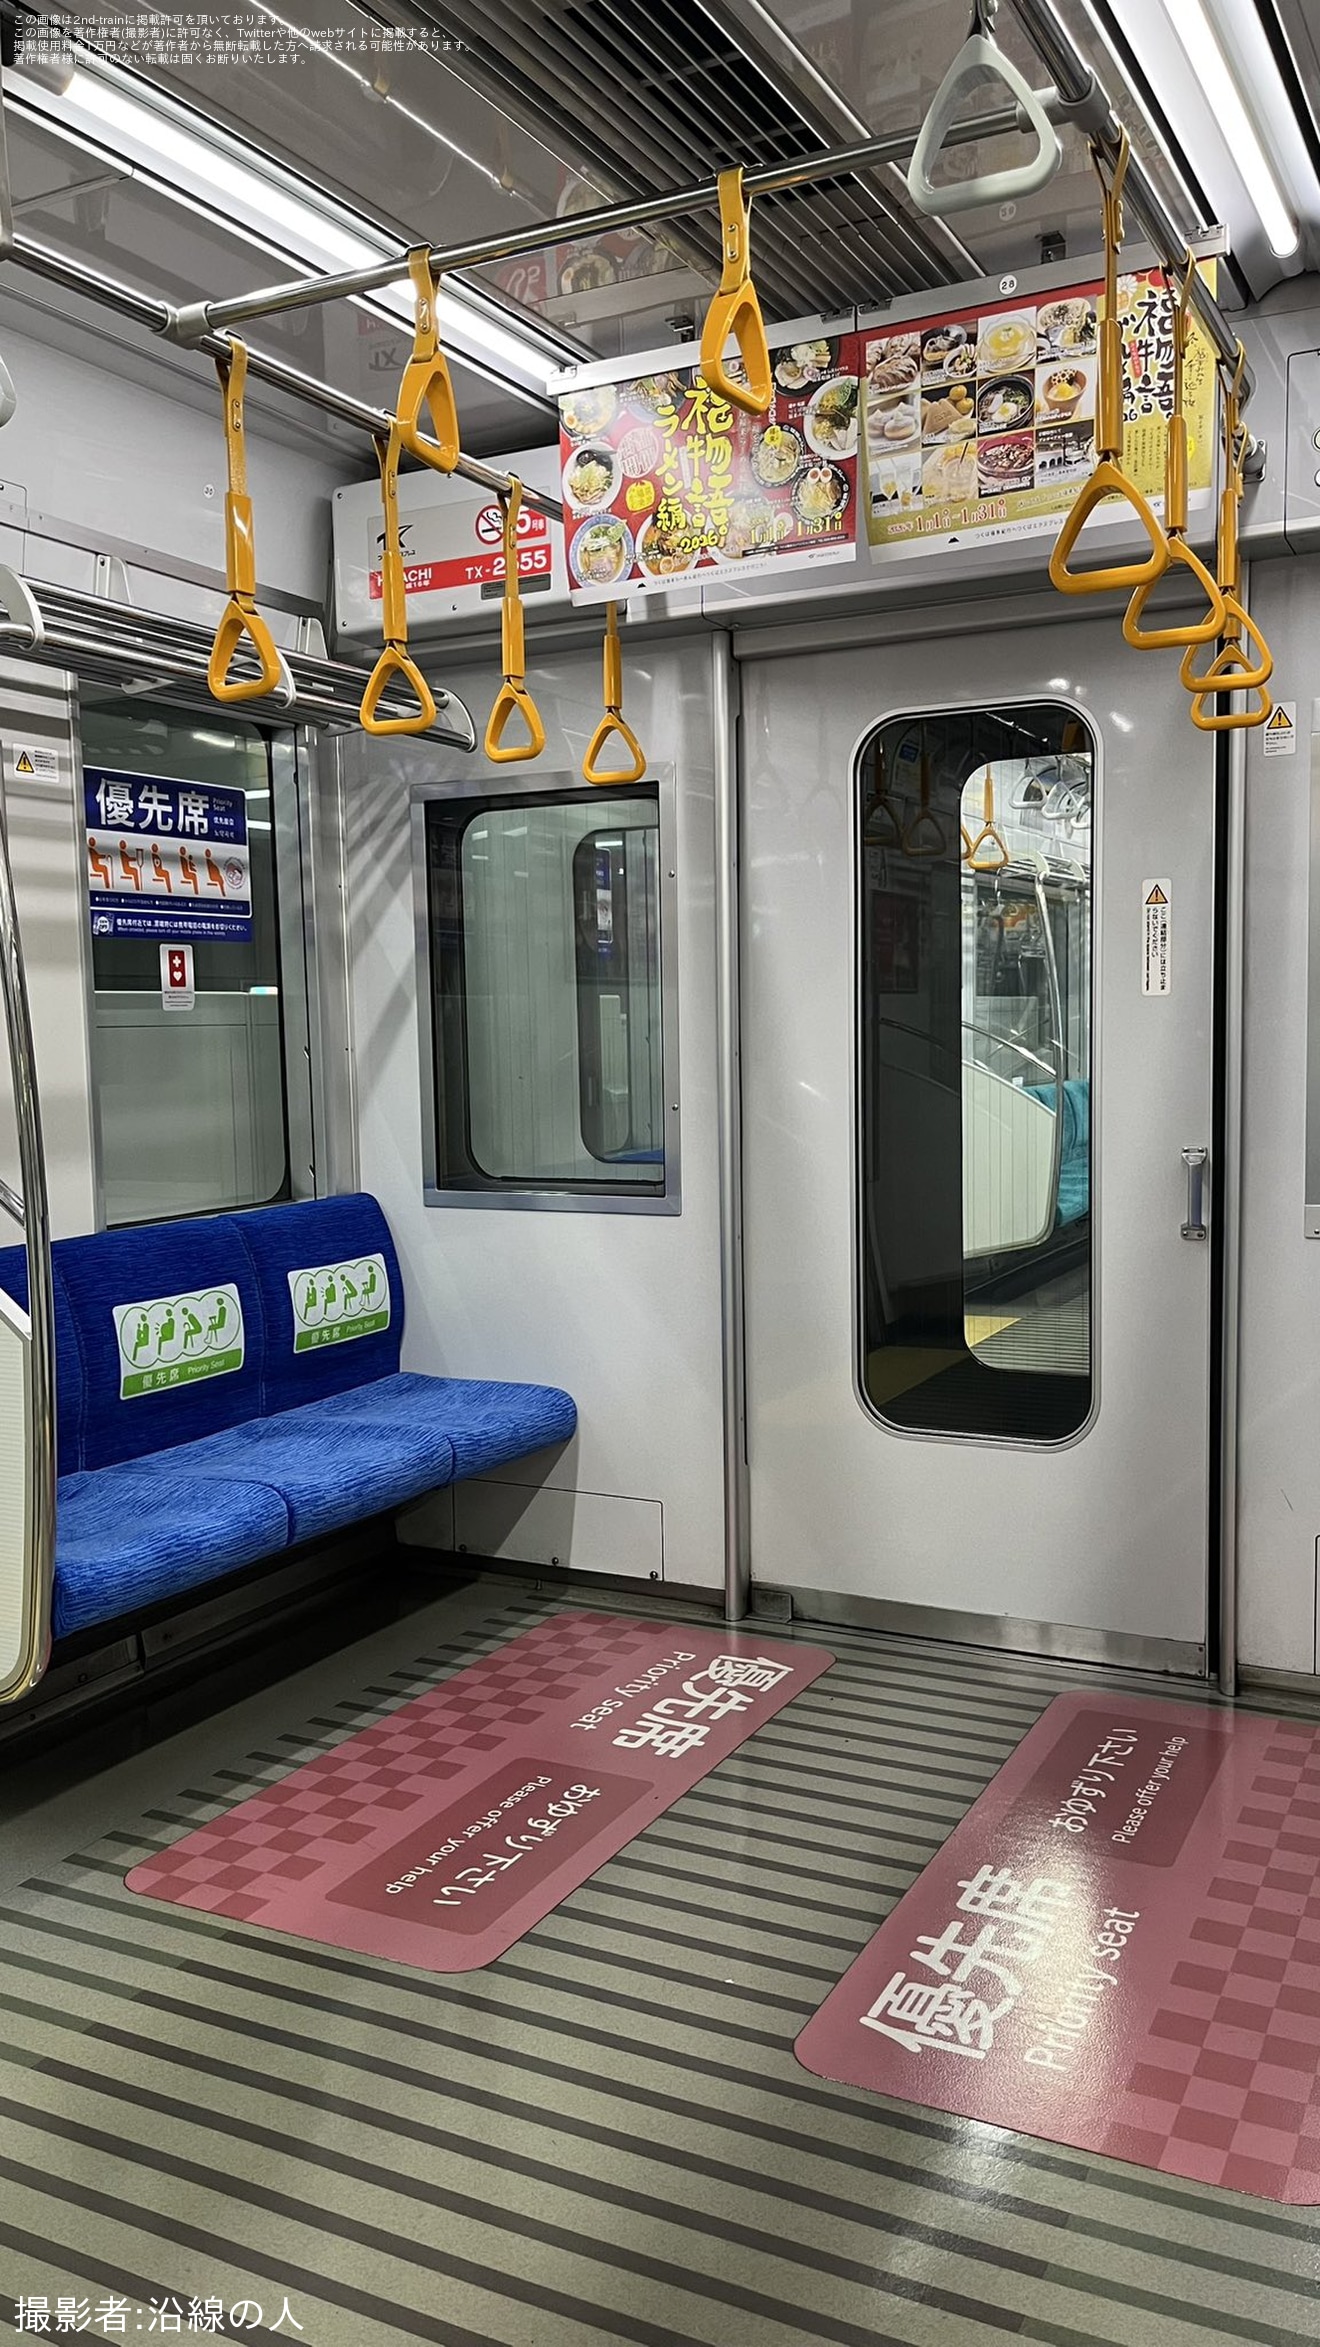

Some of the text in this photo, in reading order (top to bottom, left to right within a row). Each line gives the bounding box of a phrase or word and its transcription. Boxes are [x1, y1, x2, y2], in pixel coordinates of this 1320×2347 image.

[1001, 279, 1015, 290] 28
[465, 549, 547, 580] TX-255
[680, 531, 718, 554] 2026
[95, 777, 210, 837] 優先席
[142, 1358, 225, 1389] 優先席 Priority Seat
[311, 1318, 376, 1345] 優先席 Priority Seat
[570, 1651, 696, 1731] Priority seat
[612, 1654, 794, 1759] 優先席
[1048, 1728, 1139, 1834] おゆずり下さい
[1111, 1735, 1189, 1845] Please offer your help
[385, 1775, 553, 1894] Please offer your help
[433, 1783, 601, 1906] おゆずり下さい
[859, 1863, 1074, 2060] 優先席
[1023, 1906, 1141, 2071] Priority seat
